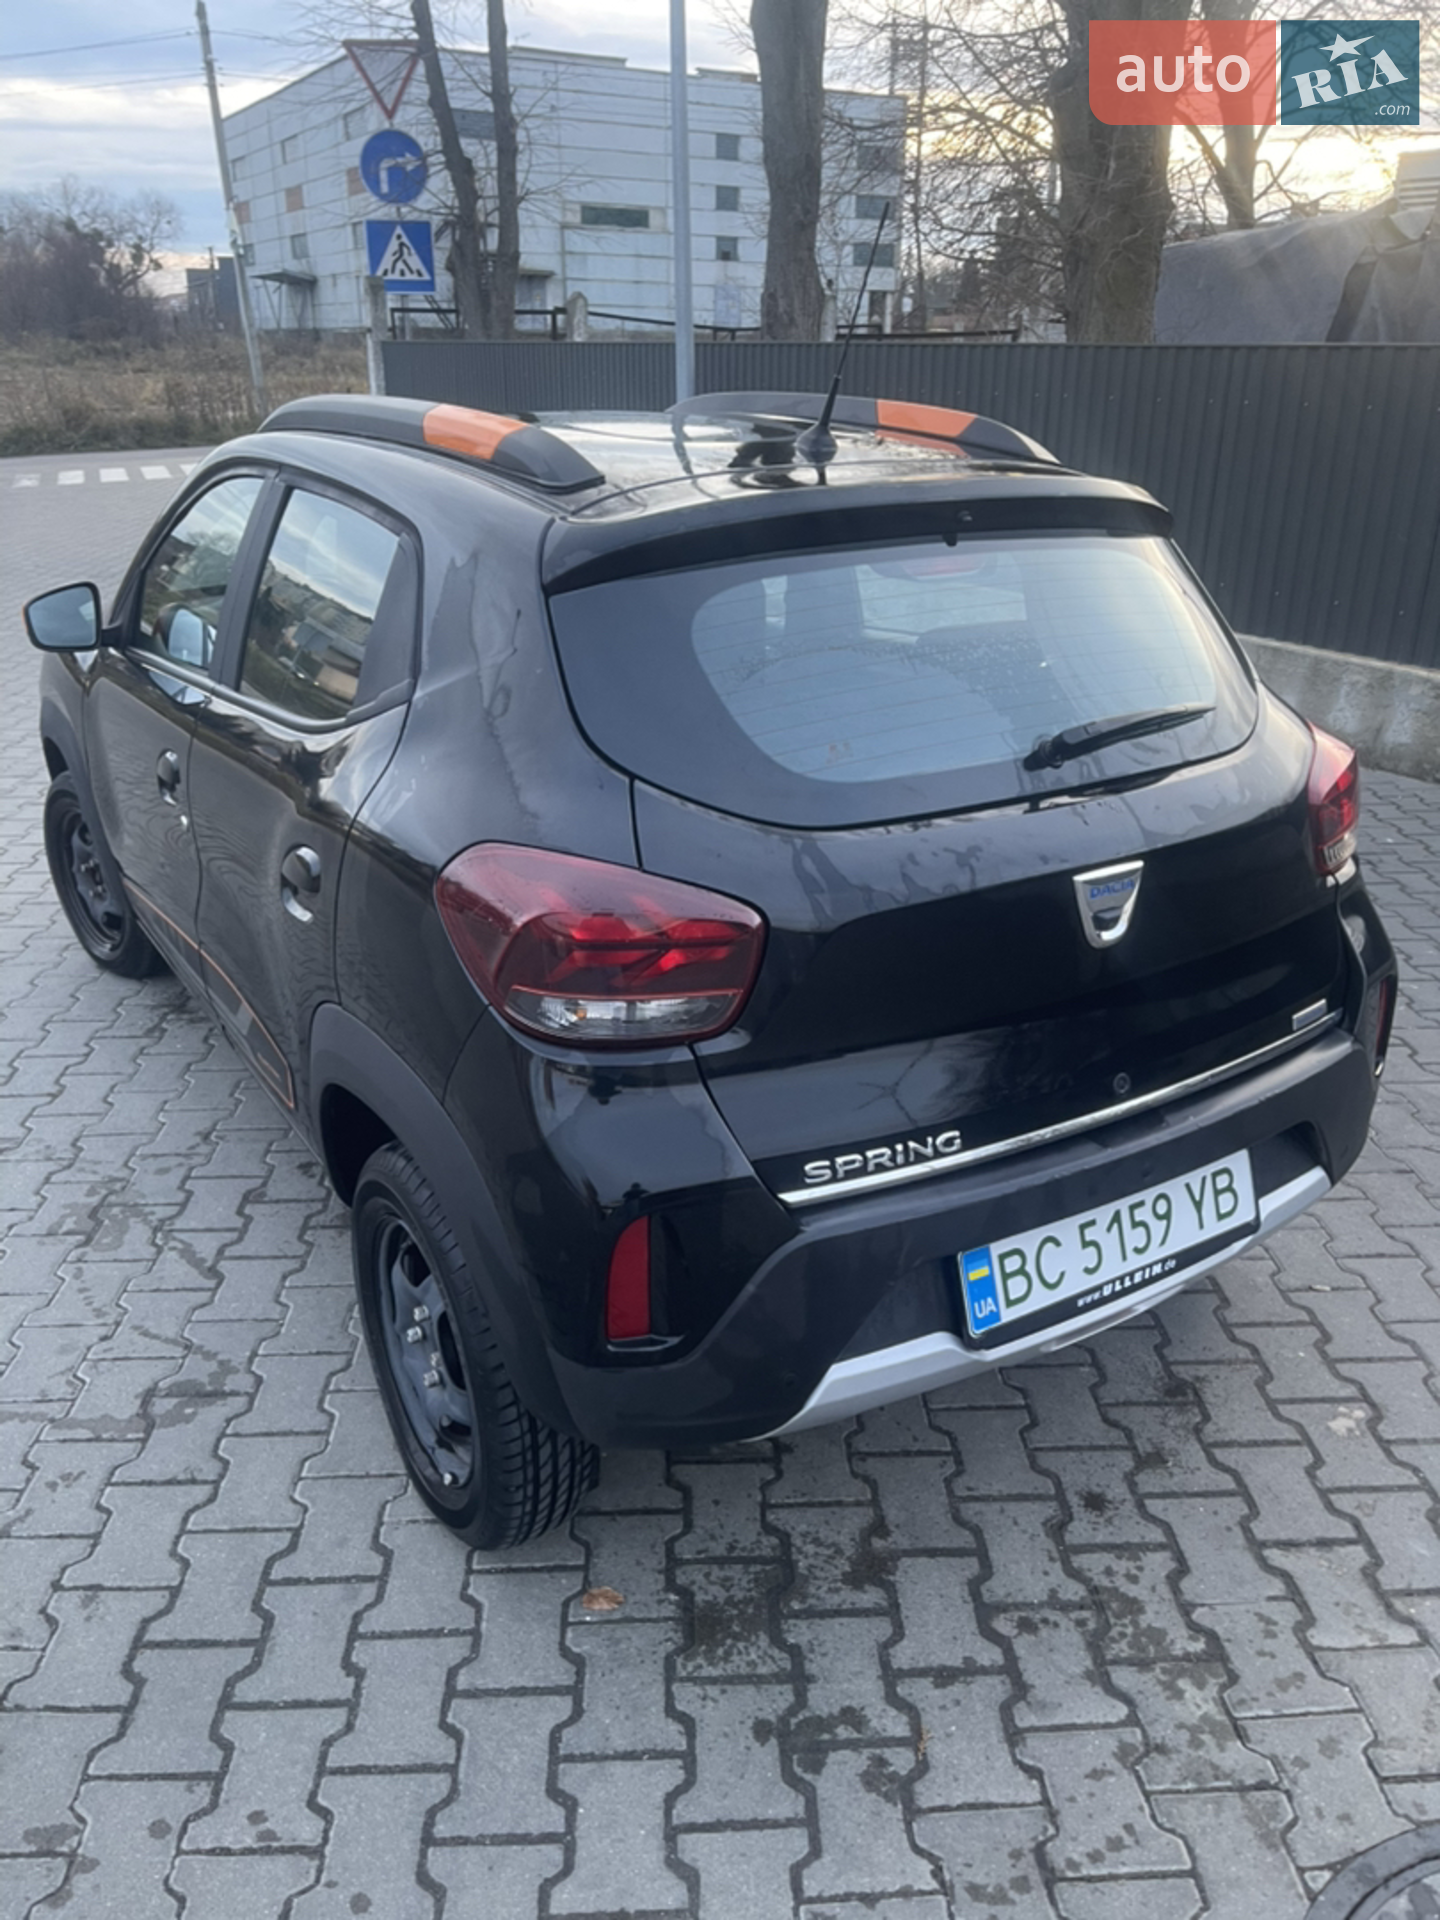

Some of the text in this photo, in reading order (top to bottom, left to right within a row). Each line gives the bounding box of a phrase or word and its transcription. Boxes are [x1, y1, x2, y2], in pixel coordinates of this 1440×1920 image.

[1090, 879, 1135, 899] DACIA
[803, 1130, 962, 1183] SPRING
[998, 1167, 1239, 1309] BC 5159 YB
[973, 1297, 997, 1319] UA
